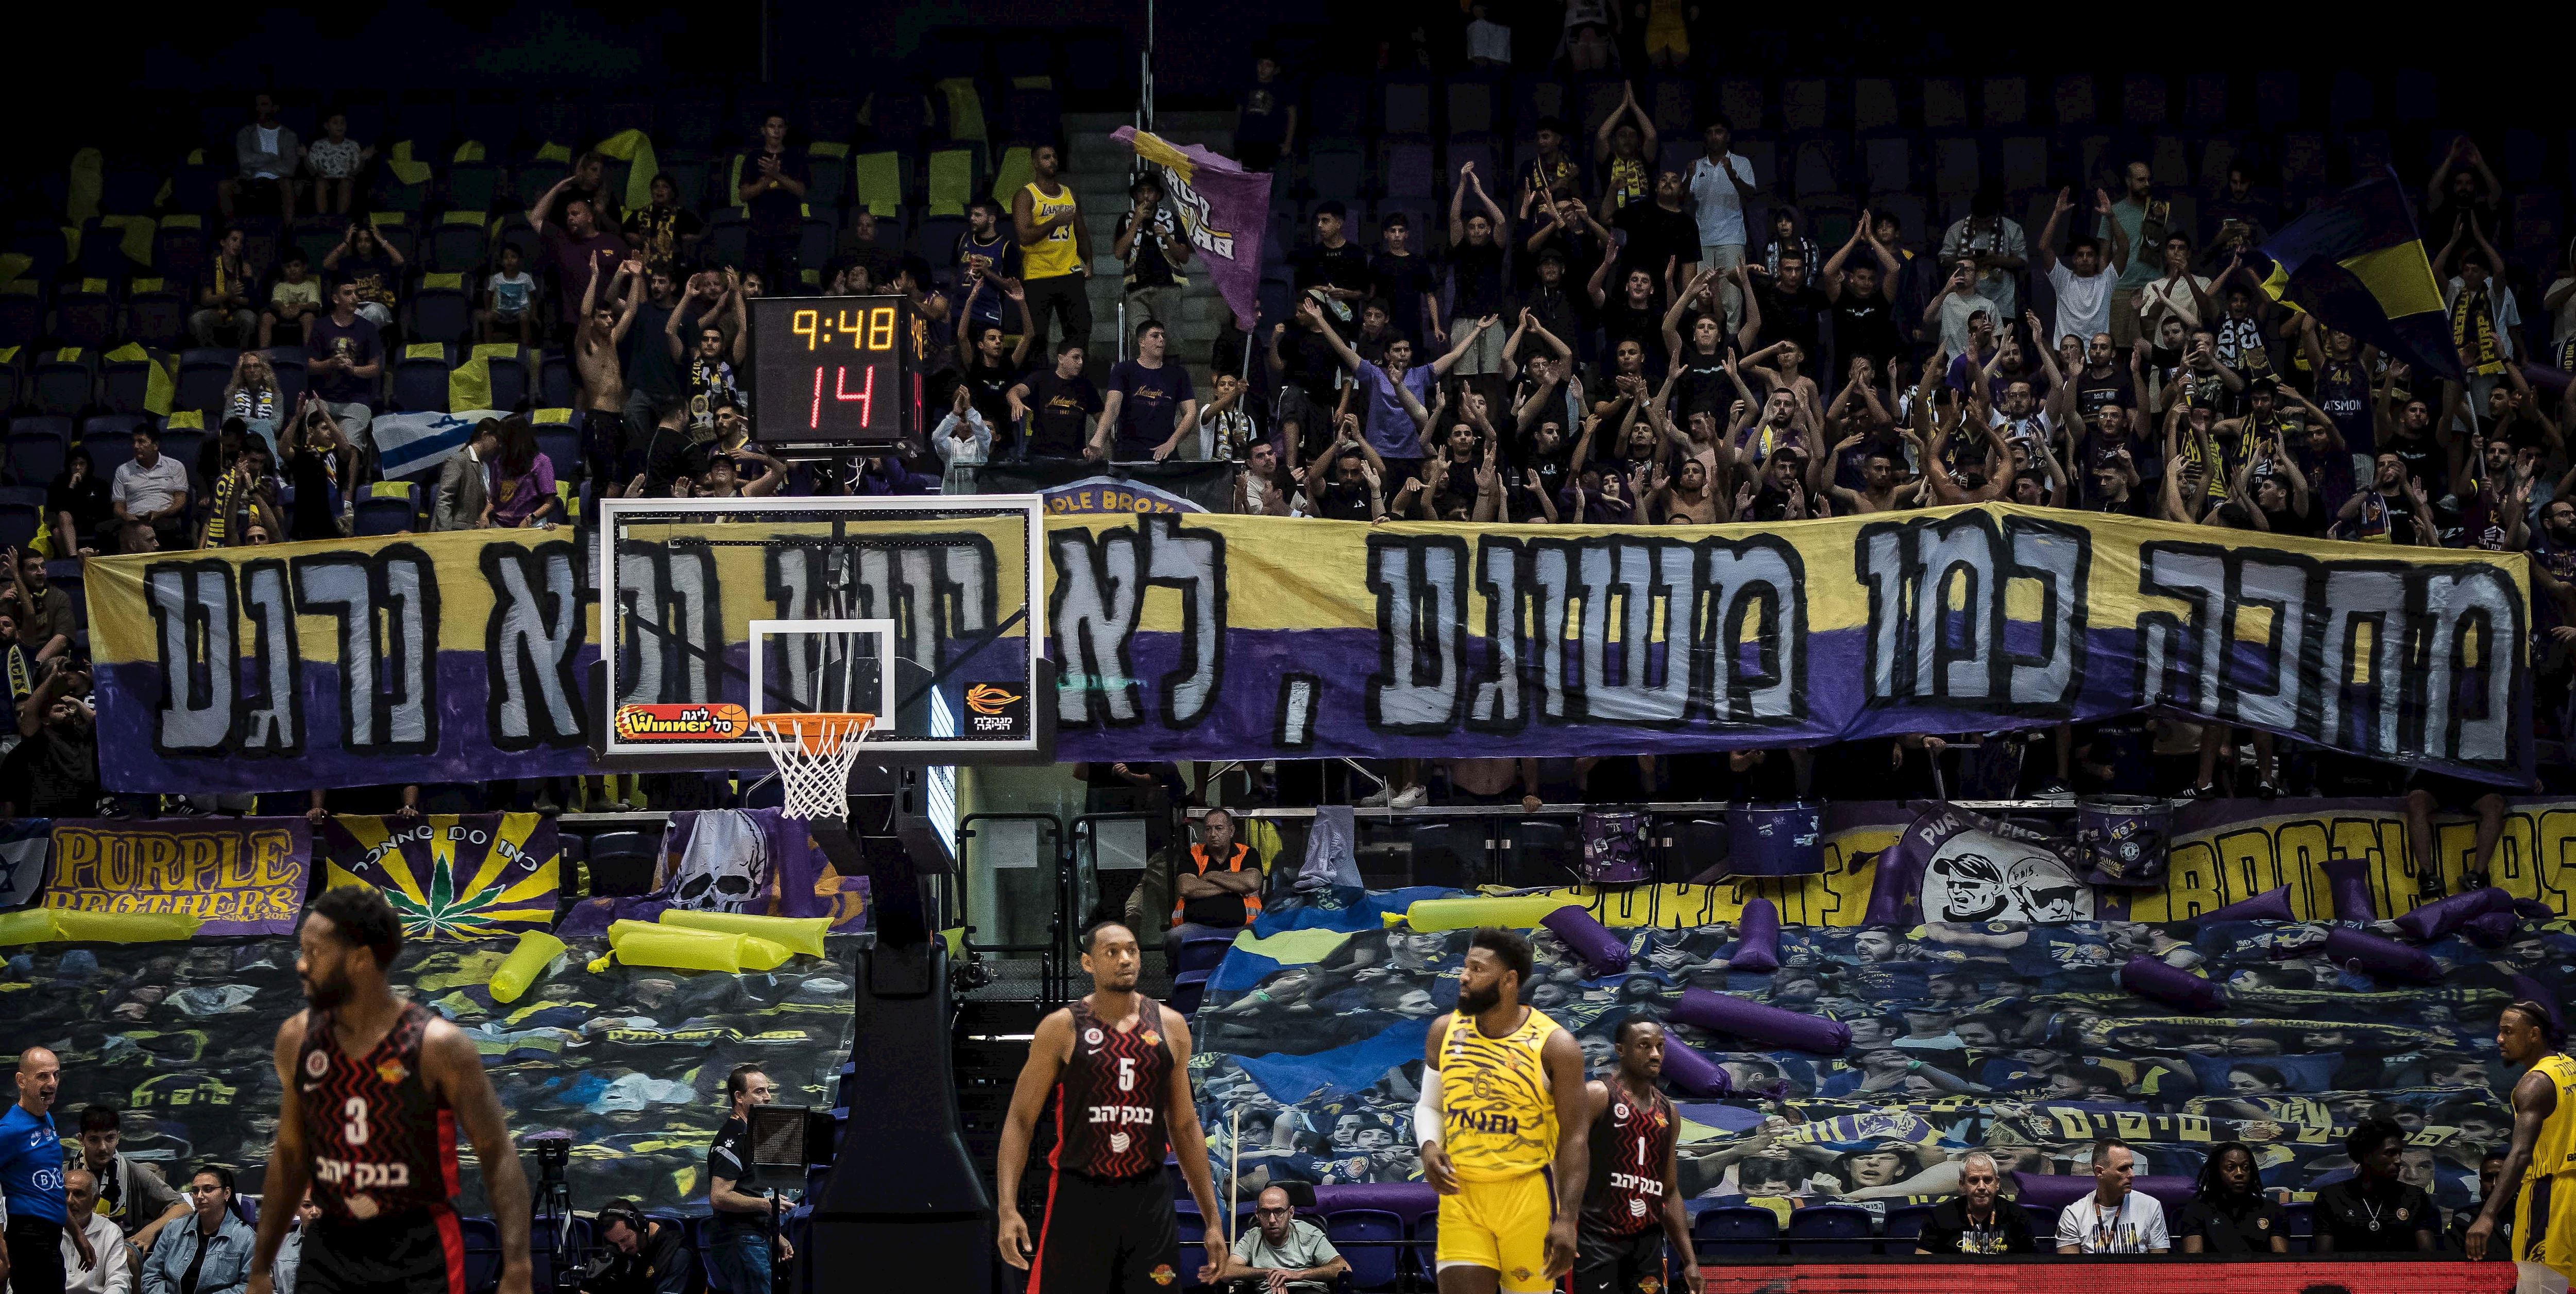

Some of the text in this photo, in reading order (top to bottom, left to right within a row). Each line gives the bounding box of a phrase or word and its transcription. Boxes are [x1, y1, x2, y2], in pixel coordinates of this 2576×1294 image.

[792, 307, 895, 351] 9:48
[810, 365, 874, 429] 14
[2323, 399, 2362, 412] ATSMON
[1048, 513, 1228, 729] לא
[1855, 508, 2090, 709] כמו
[144, 542, 442, 757] נרגע
[1365, 533, 1807, 734] משוגע
[2138, 540, 2530, 768] מחכה
[631, 714, 711, 732] Winner
[681, 707, 709, 721] ליגת
[713, 717, 732, 732] סל
[974, 716, 1013, 724] מנהלת
[976, 722, 1010, 730] הליגה
[49, 827, 300, 890] PURPLE
[1118, 1058, 1136, 1091] 5
[1473, 1068, 1493, 1099] 6
[345, 1096, 369, 1146] 3
[1638, 1136, 1646, 1166] 1
